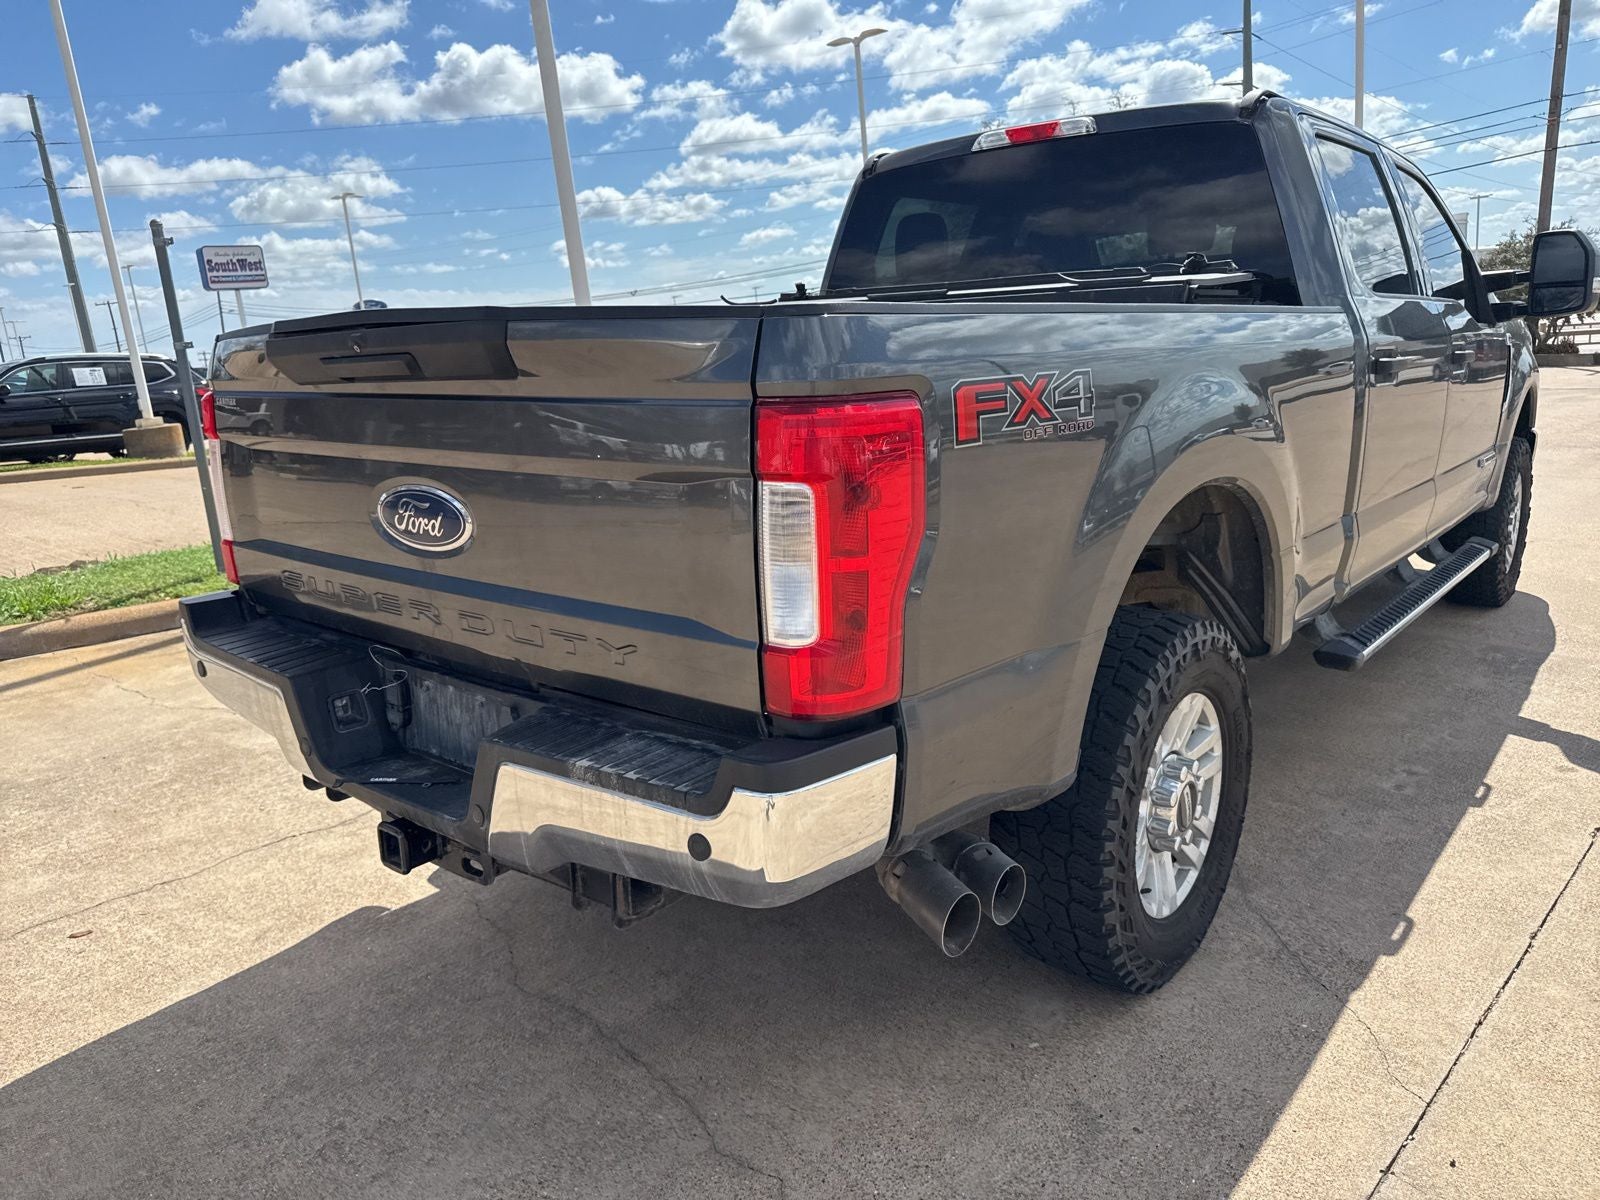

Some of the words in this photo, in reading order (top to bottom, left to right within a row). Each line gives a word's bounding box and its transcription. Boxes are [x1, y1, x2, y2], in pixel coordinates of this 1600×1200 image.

[951, 368, 1096, 449] FX4
[1023, 425, 1054, 441] OFF
[1058, 419, 1096, 436] ROAD
[394, 498, 444, 537] Ford
[281, 569, 443, 626] SUPER
[458, 608, 638, 667] DUTY
